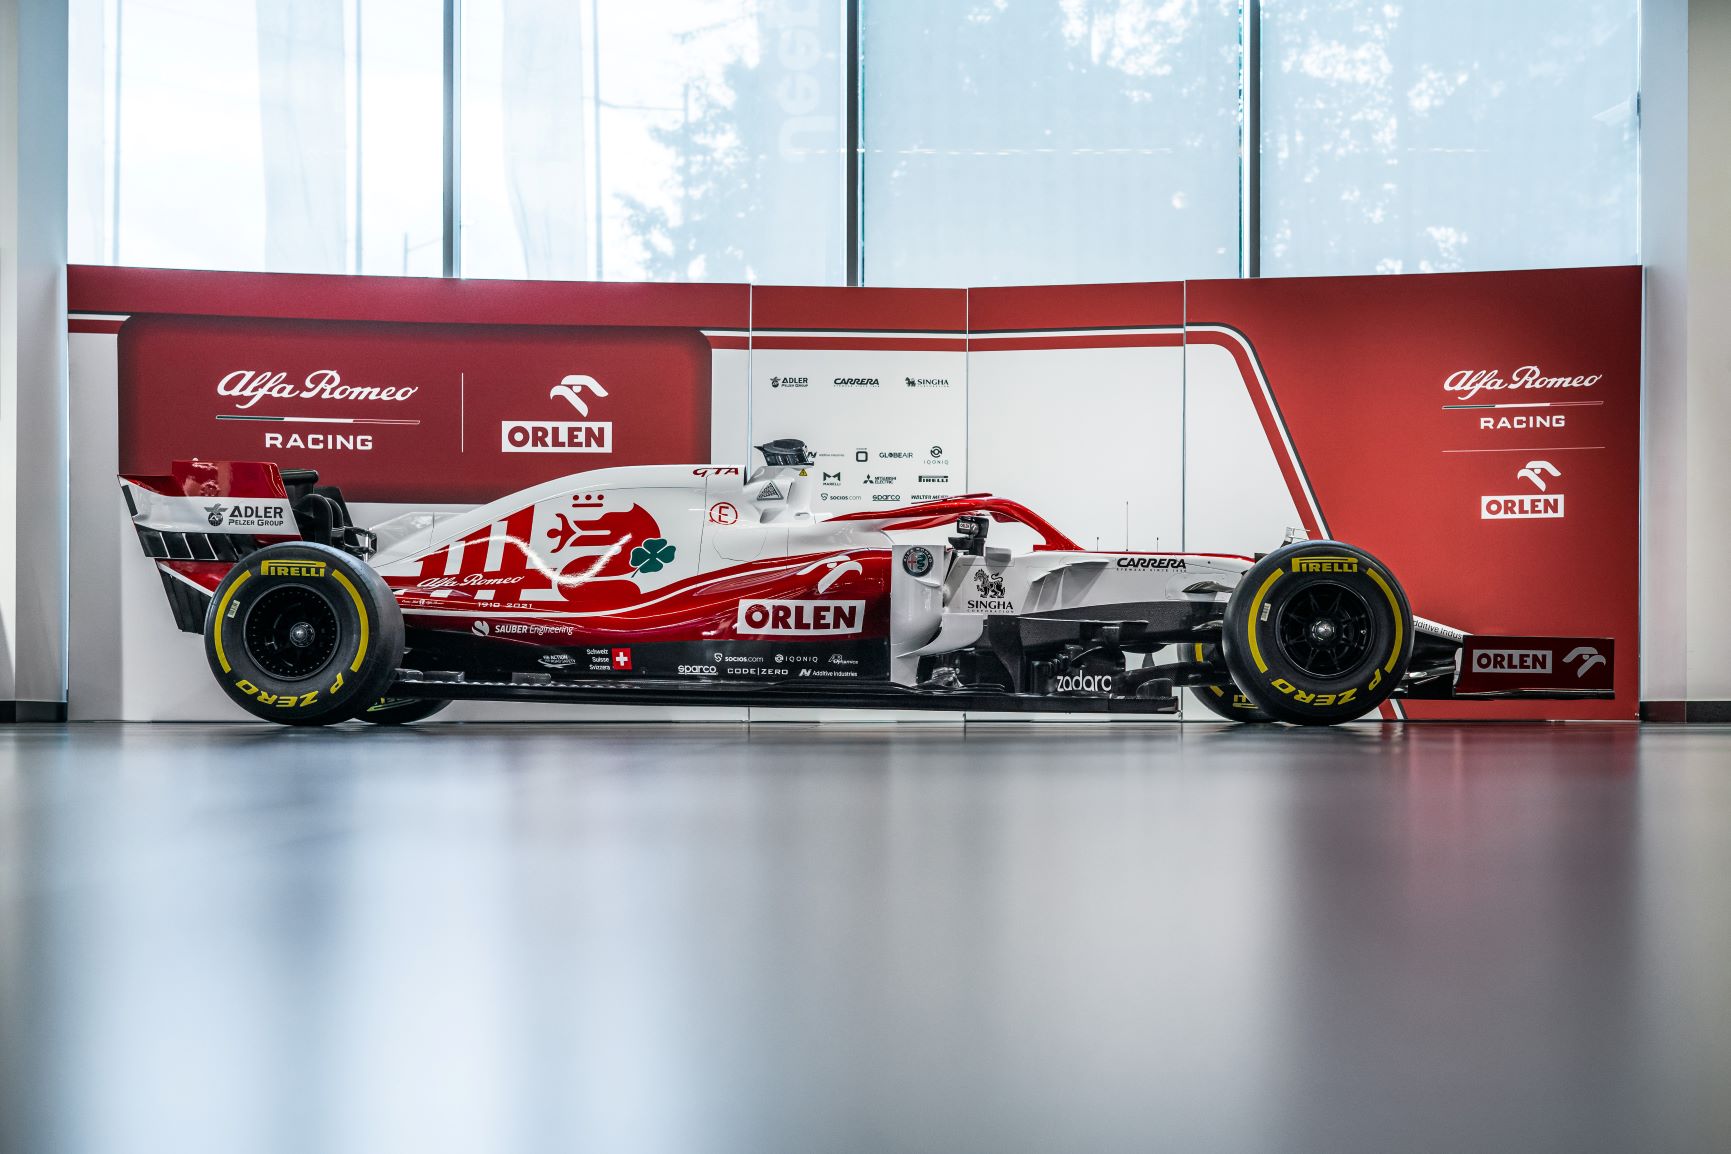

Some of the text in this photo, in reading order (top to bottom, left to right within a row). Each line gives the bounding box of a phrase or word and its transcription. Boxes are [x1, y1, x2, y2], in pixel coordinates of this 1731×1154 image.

[217, 369, 418, 409] Alfa Romeo
[834, 378, 880, 386] CARRERA
[917, 378, 949, 386] SINGHA
[1443, 365, 1602, 400] Alfa Romeo
[1480, 415, 1566, 429] RACING
[265, 433, 373, 450] RACING
[507, 425, 605, 448] ORLEN
[693, 467, 739, 477] GTA
[918, 475, 949, 483] PIRELLI
[872, 494, 901, 502] sparco
[229, 505, 284, 519] ADLER
[1485, 498, 1559, 515] ORLEN
[228, 518, 284, 527] PELZER GROUP
[261, 560, 327, 577] PIRELLI
[1117, 557, 1187, 568] CARRERA
[1292, 556, 1359, 573] PIRELLI
[417, 573, 526, 590] Alfa Romeo
[967, 600, 1014, 610] SINGHA
[745, 603, 857, 630] ORLEN
[494, 625, 574, 636] SAUBER Engineering
[1412, 620, 1439, 631] dditive
[1476, 653, 1547, 670] ORLEN
[678, 664, 719, 675] sparco
[1368, 668, 1382, 691] P
[235, 672, 344, 708] P ZERO
[1271, 678, 1358, 706] ZERO
